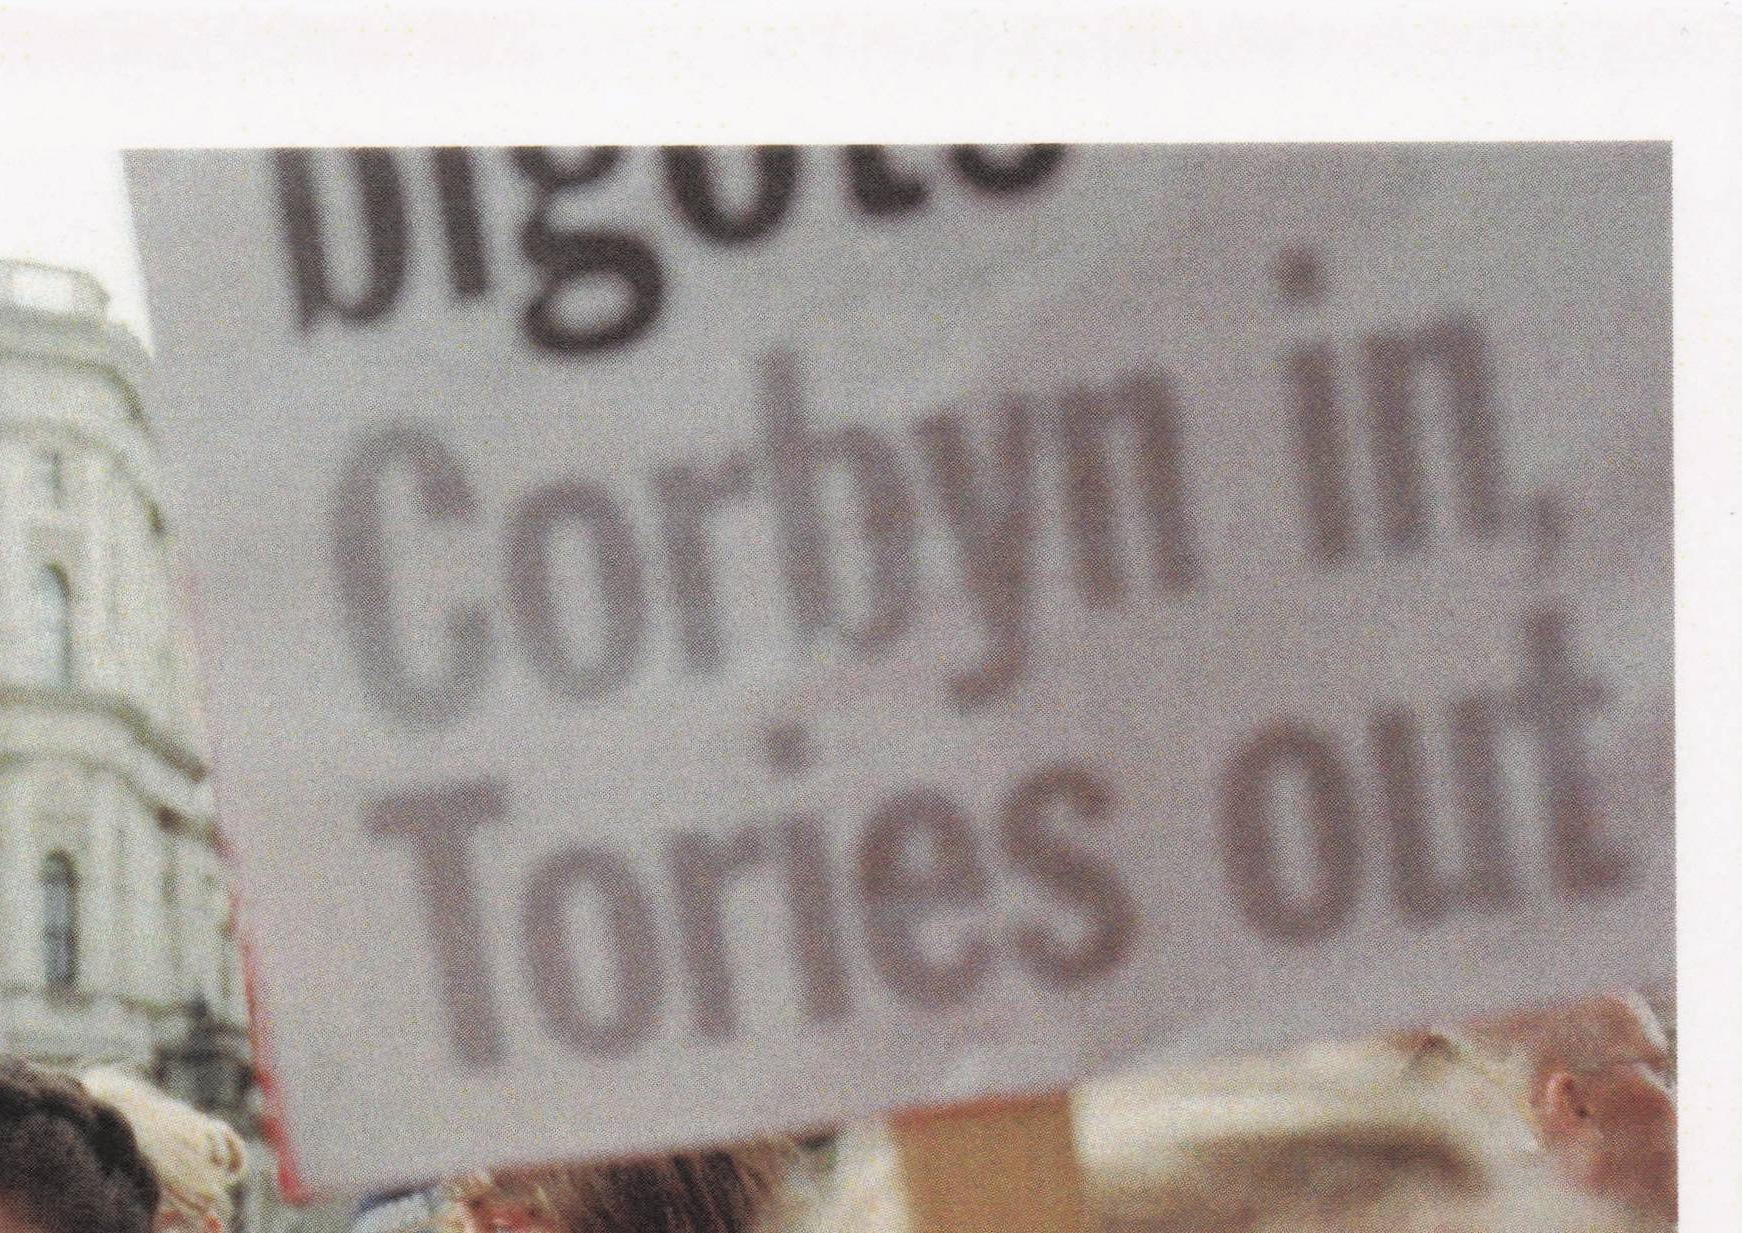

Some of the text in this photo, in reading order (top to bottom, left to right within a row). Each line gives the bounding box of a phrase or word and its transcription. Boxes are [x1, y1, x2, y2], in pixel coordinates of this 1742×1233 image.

[272, 146, 1064, 360] big
[326, 240, 1574, 730] Corbyn in,
[366, 608, 1640, 1074] Tories out
